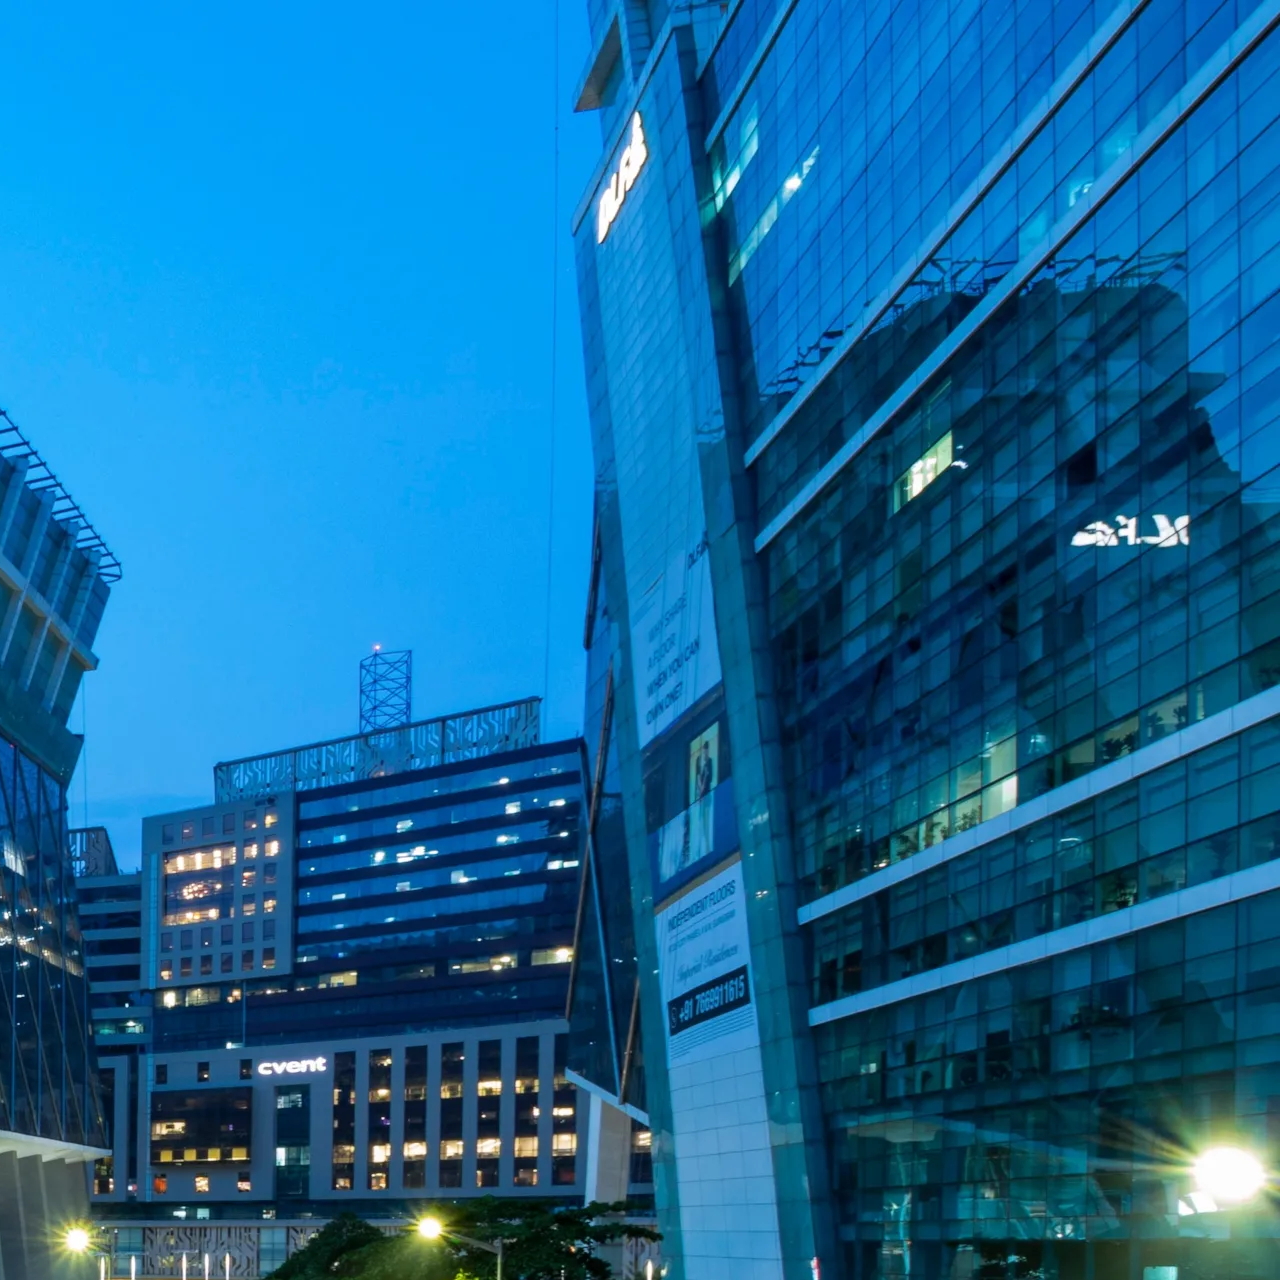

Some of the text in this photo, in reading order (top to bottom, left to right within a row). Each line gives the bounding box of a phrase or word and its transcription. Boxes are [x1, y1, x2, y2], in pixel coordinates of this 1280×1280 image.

[647, 668, 667, 698] WHEN
[684, 637, 699, 661] CAN
[668, 895, 709, 933] INDEPENDENT
[709, 879, 736, 908] FLOORS
[679, 998, 694, 1022] +91
[258, 1056, 327, 1075] cvent
